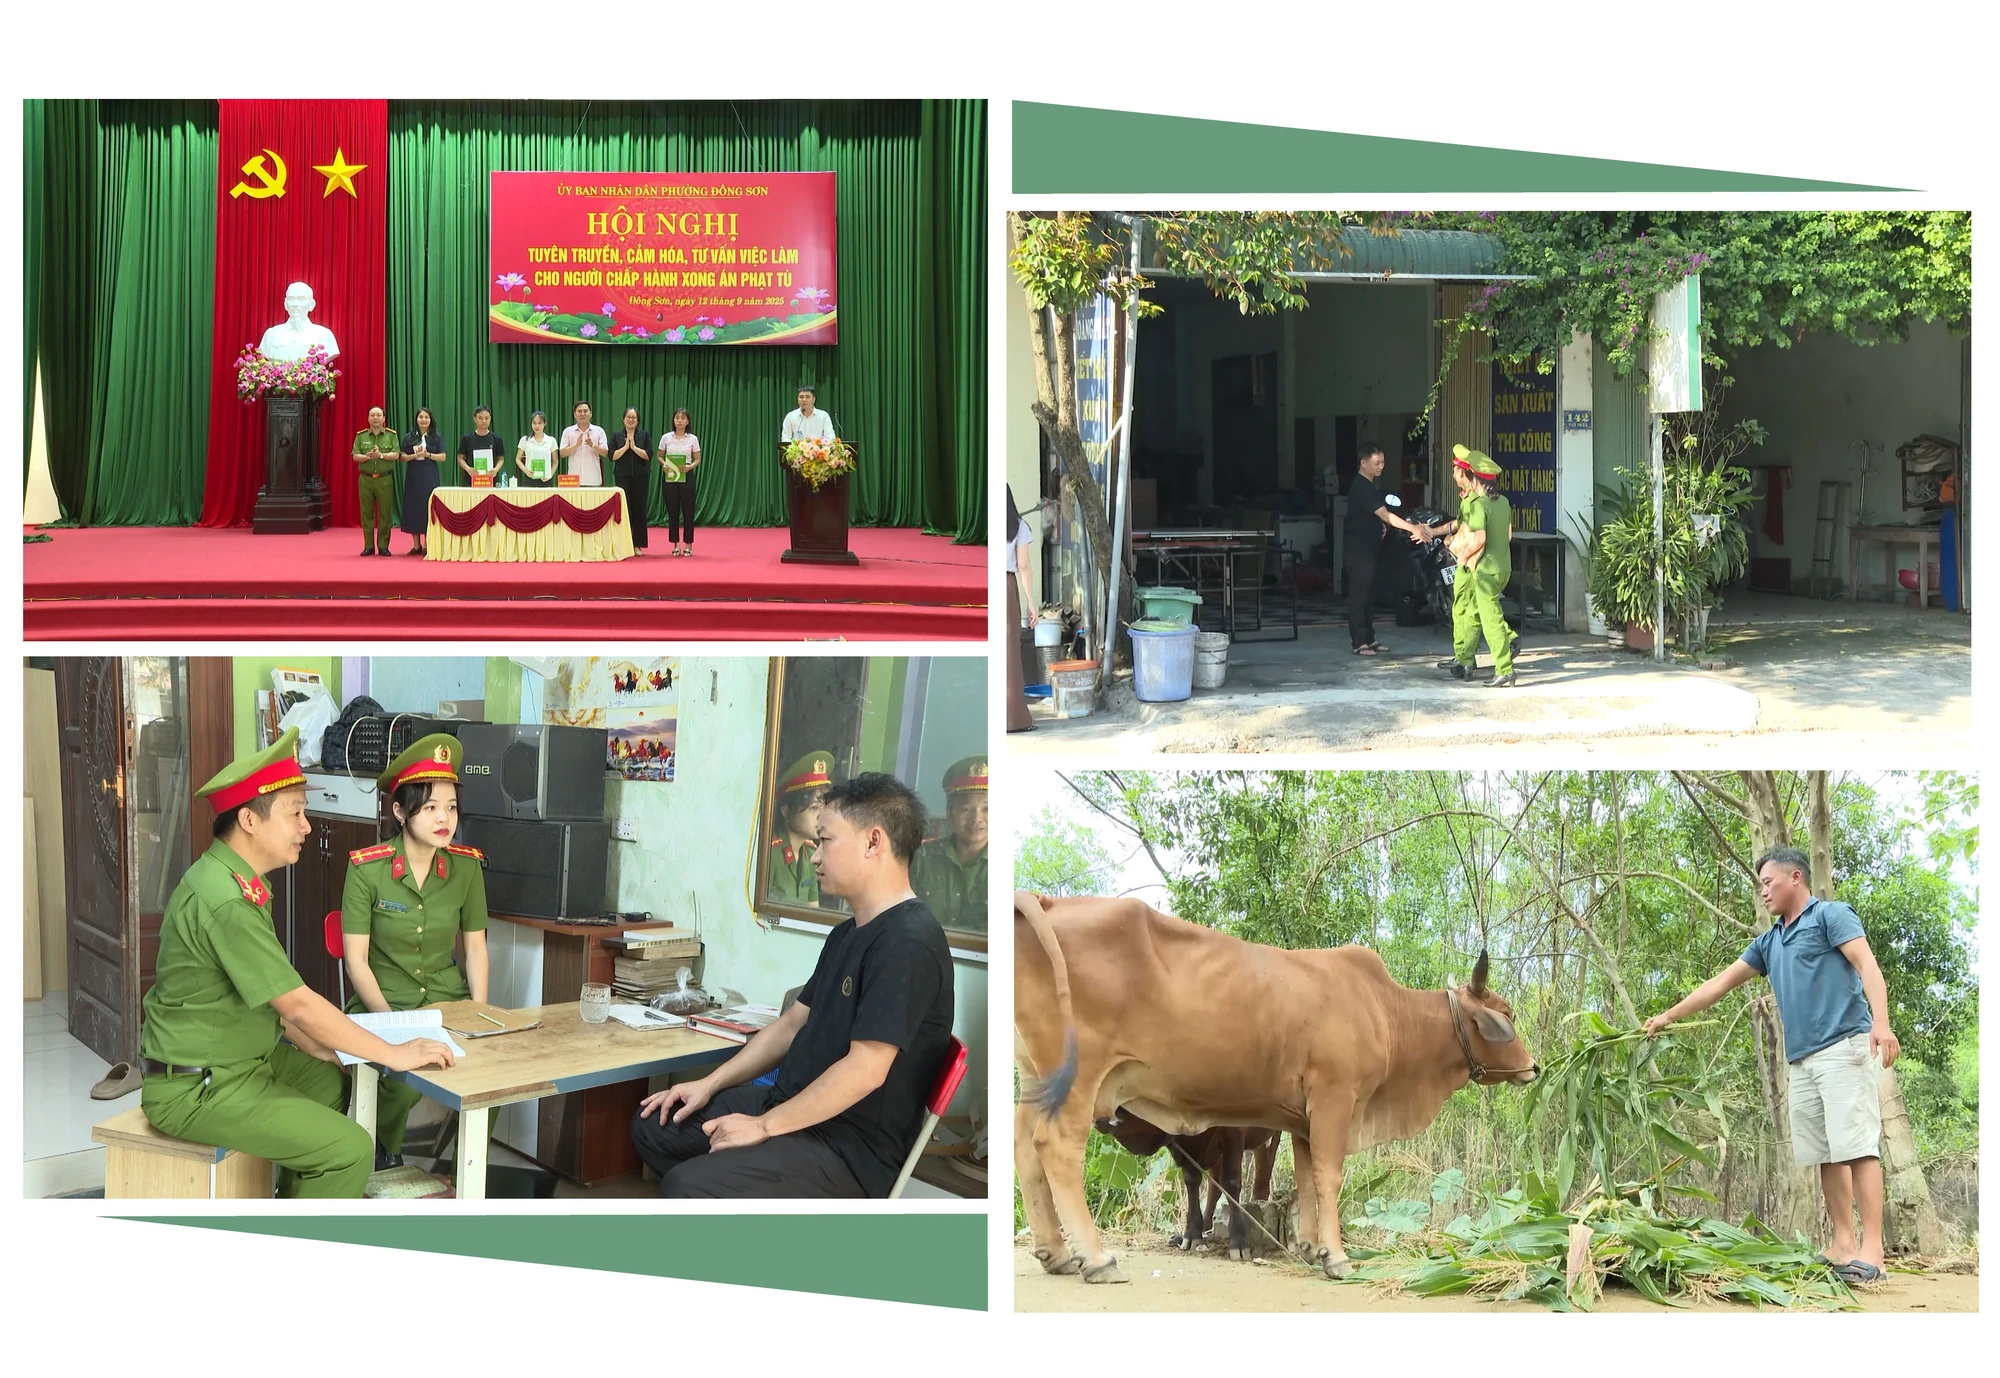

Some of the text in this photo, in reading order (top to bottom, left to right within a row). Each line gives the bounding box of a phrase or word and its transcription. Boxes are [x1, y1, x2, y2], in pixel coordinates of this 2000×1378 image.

[557, 182, 769, 197] ỦY BAN NHÂN DÂN PHƯỜNG ĐÔNG SƠN
[586, 205, 739, 242] HỘI NGHỊ
[528, 244, 799, 267] TUYÊN TRUYỀN, CẢM HÓA, TƯ VẤN VIỆC LÀM
[534, 266, 793, 291] CHO NGƯỜI CHẤP HÀNH XONG ÁN PHẠT TÙ
[628, 295, 785, 308] Đông Sơn, ngày 12 tháng 9 năm 2025
[1494, 385, 1554, 415] SẢN XUẤT
[1567, 413, 1589, 422] 142
[1496, 428, 1552, 453] THI CÔNG
[1512, 464, 1529, 496] MẶT
[1531, 464, 1555, 492] HÀNG
[1521, 500, 1542, 532] THẤT
